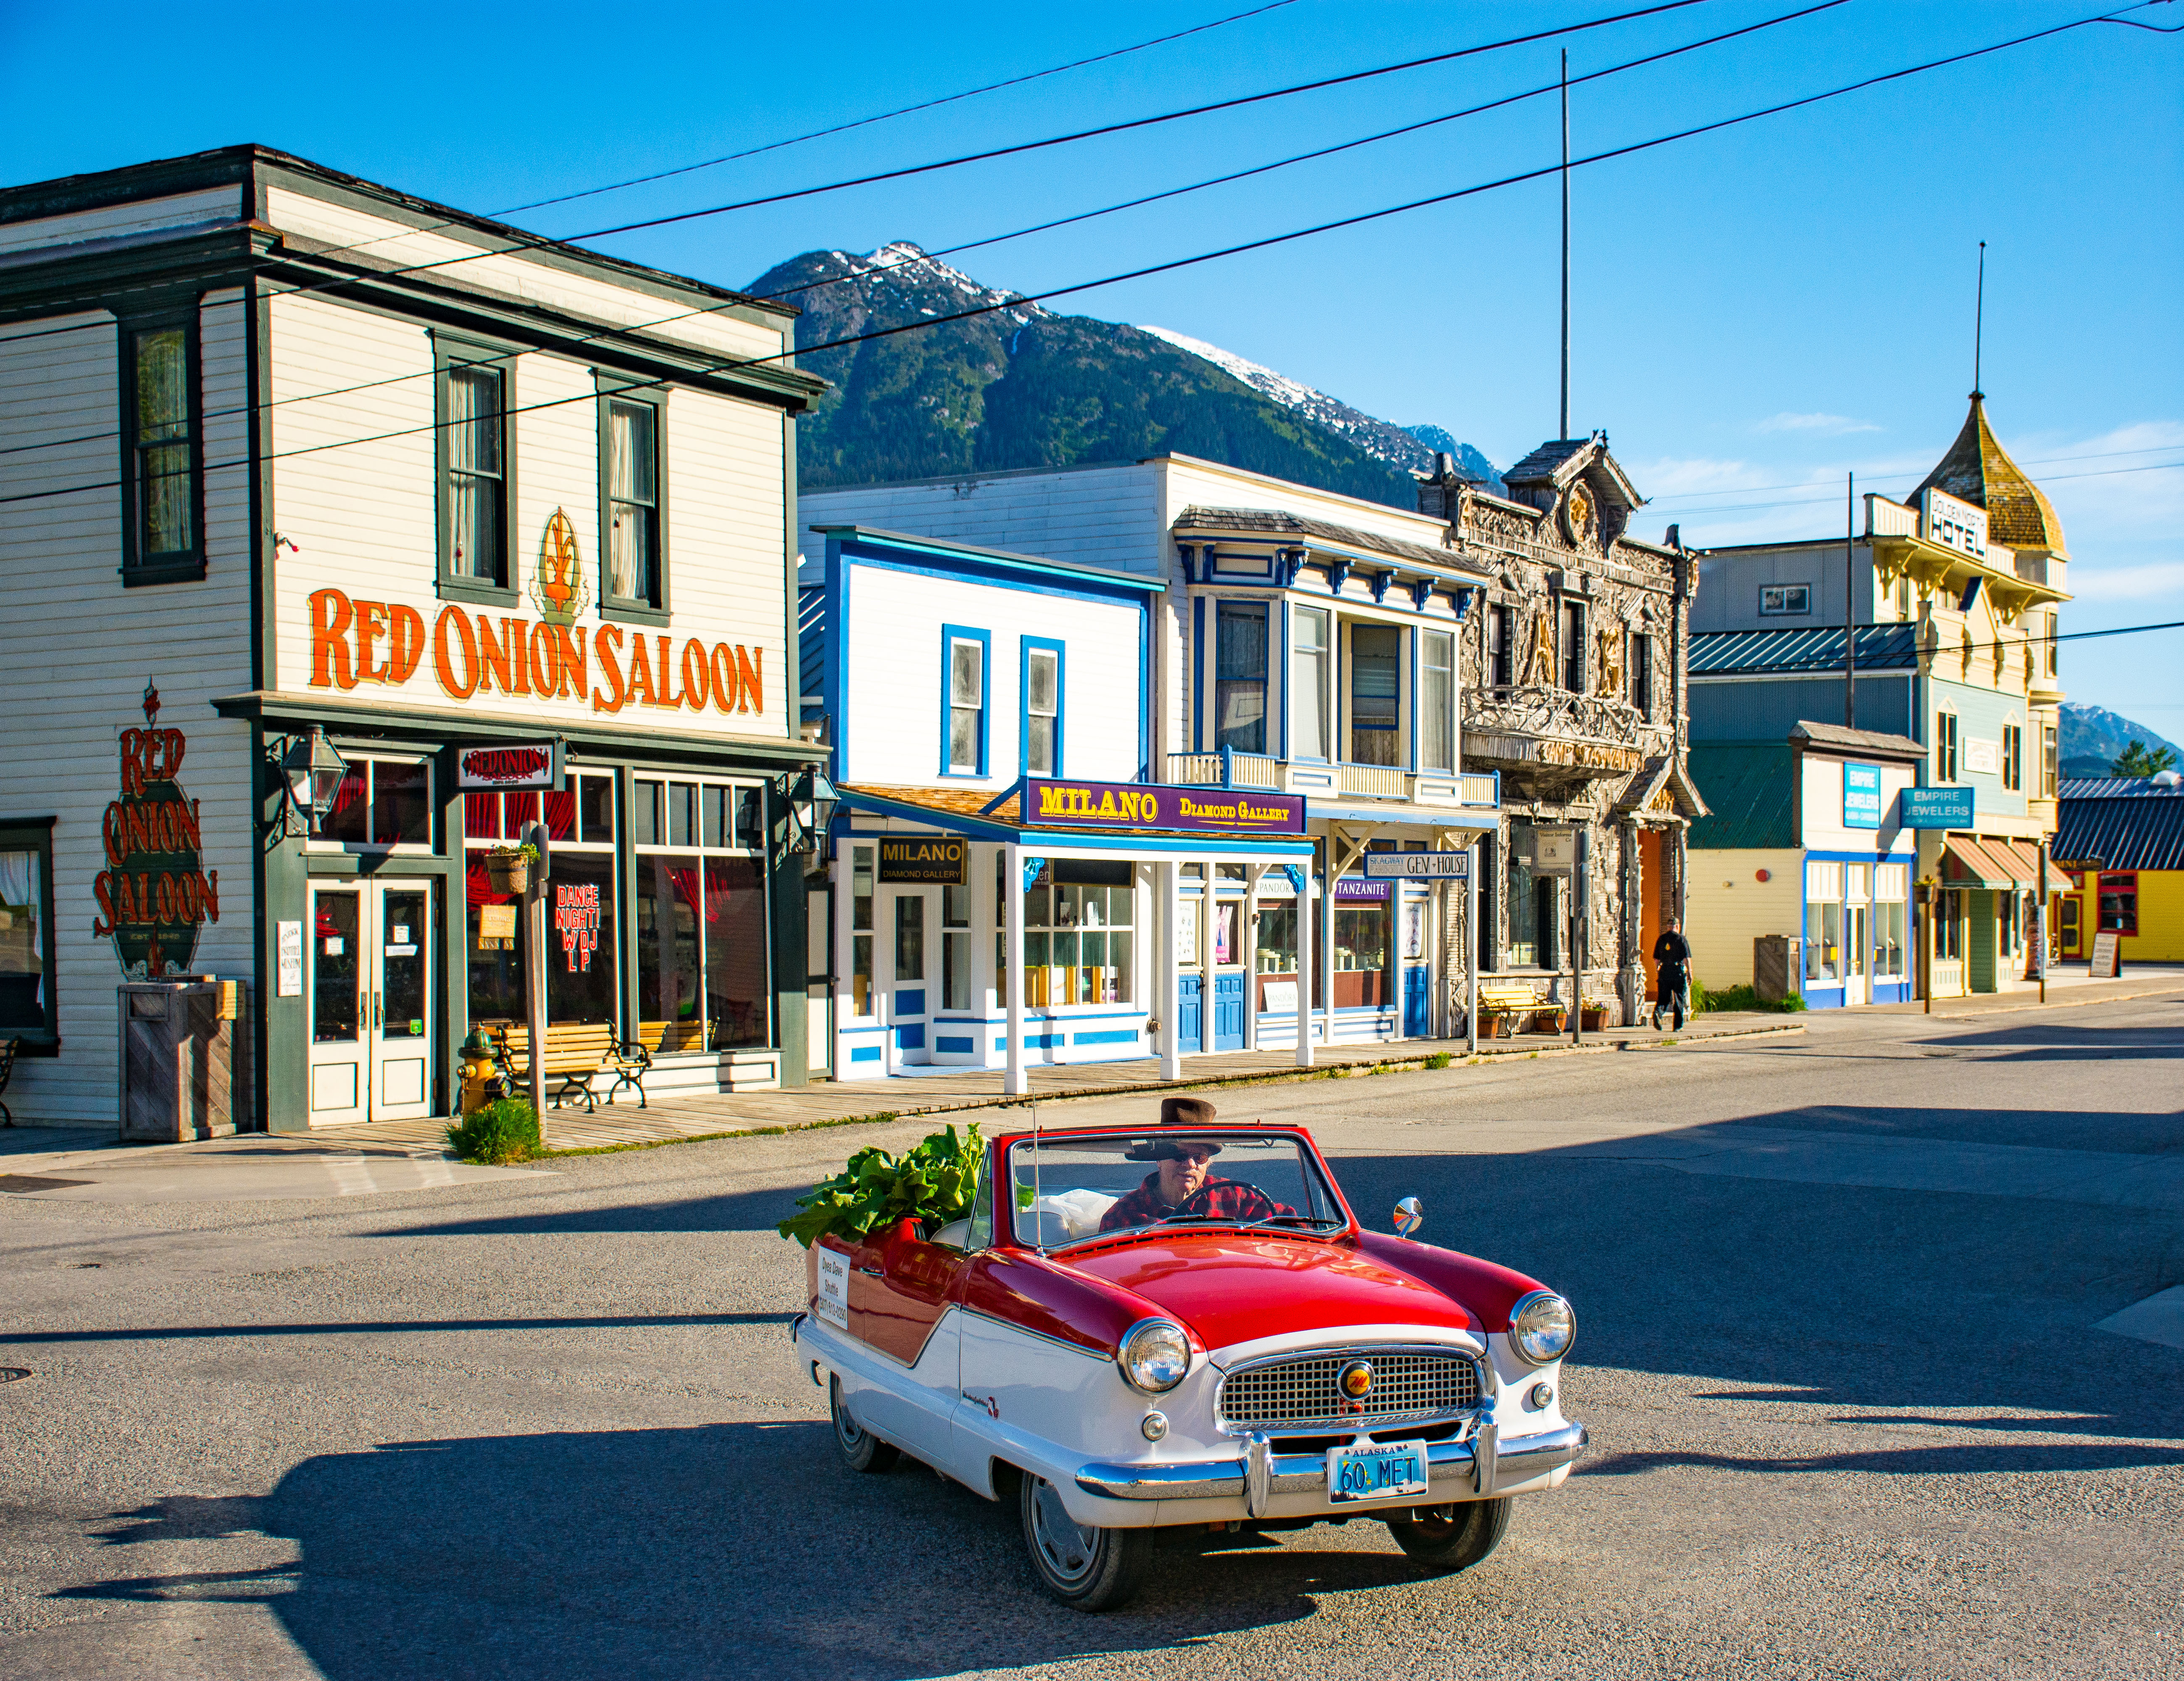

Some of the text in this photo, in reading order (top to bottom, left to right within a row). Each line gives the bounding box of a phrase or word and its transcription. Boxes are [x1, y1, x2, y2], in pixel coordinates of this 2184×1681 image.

[1931, 514, 1984, 557] HOTEL
[308, 588, 763, 716] RED ONION SALOON
[120, 727, 186, 798] RED
[469, 748, 542, 777] RED ONION
[482, 772, 533, 781] SALOON
[1850, 770, 1875, 788] EMPIRE
[1039, 786, 1289, 823] MILANO DIAMOND GALLERY
[1845, 792, 1879, 810] JEWELERS
[1914, 791, 1960, 802] EMPIRE
[1906, 806, 1969, 816] JEWELERS
[102, 798, 201, 867] ONION
[884, 844, 961, 861] MILANO
[1407, 856, 1466, 874] GEM HOUSE
[557, 885, 599, 907] DANCE
[1260, 882, 1295, 893] PANDORA
[1338, 883, 1385, 895] TANZANITE
[93, 869, 220, 939] SALOON
[555, 907, 601, 930] NIGHT!
[822, 1257, 843, 1277] Dyea Dave
[825, 1278, 839, 1297] Shuttle
[1353, 1447, 1395, 1457] ALASKA
[1340, 1456, 1417, 1490] 60 MET
